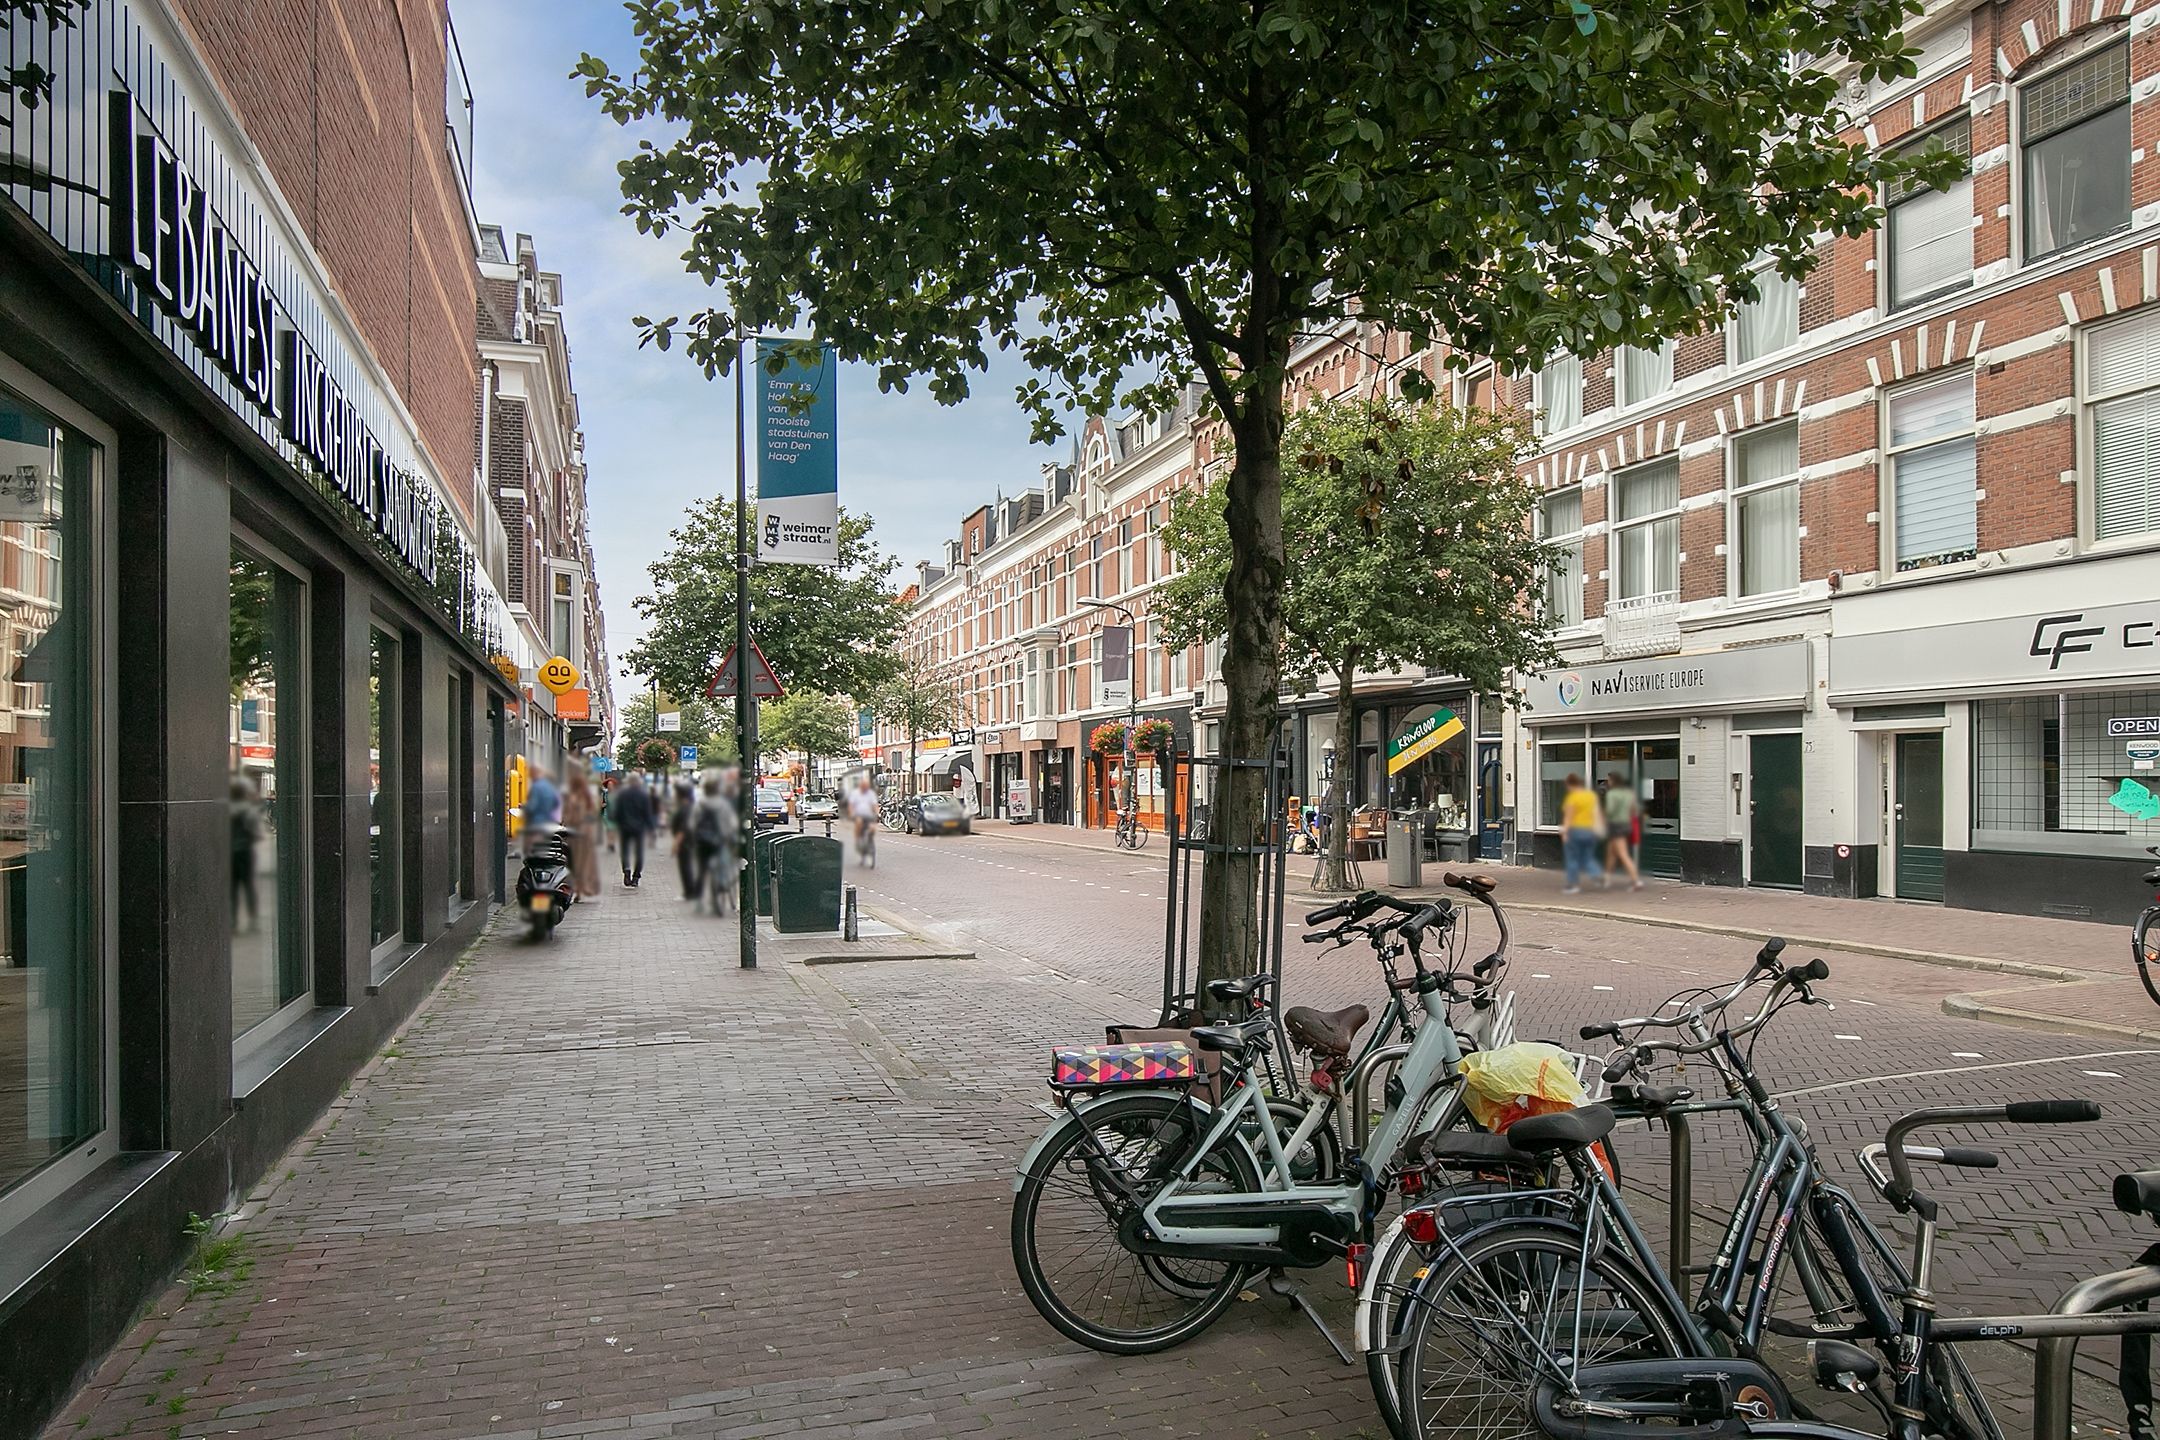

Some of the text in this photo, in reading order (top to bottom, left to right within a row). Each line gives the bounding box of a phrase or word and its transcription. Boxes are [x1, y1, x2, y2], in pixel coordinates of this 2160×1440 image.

[129, 91, 282, 420] LEBANESE
[293, 329, 378, 522] INCREDIBLE
[768, 405, 787, 413] van
[768, 417, 810, 427] mooiste
[768, 429, 829, 439] stadstuinen
[768, 441, 811, 450] van Den
[782, 523, 832, 534] weimar
[782, 532, 832, 544] straat.nl
[1669, 669, 1704, 689] EUROPE
[2111, 720, 2158, 733] OPEN
[2129, 742, 2159, 750] KENWOOD
[1264, 1054, 1286, 1099] MULTICYCL
[1392, 1095, 1416, 1136] GAZELLE
[1724, 1199, 1751, 1256] azelle
[1758, 1221, 1788, 1293] Locomotief
